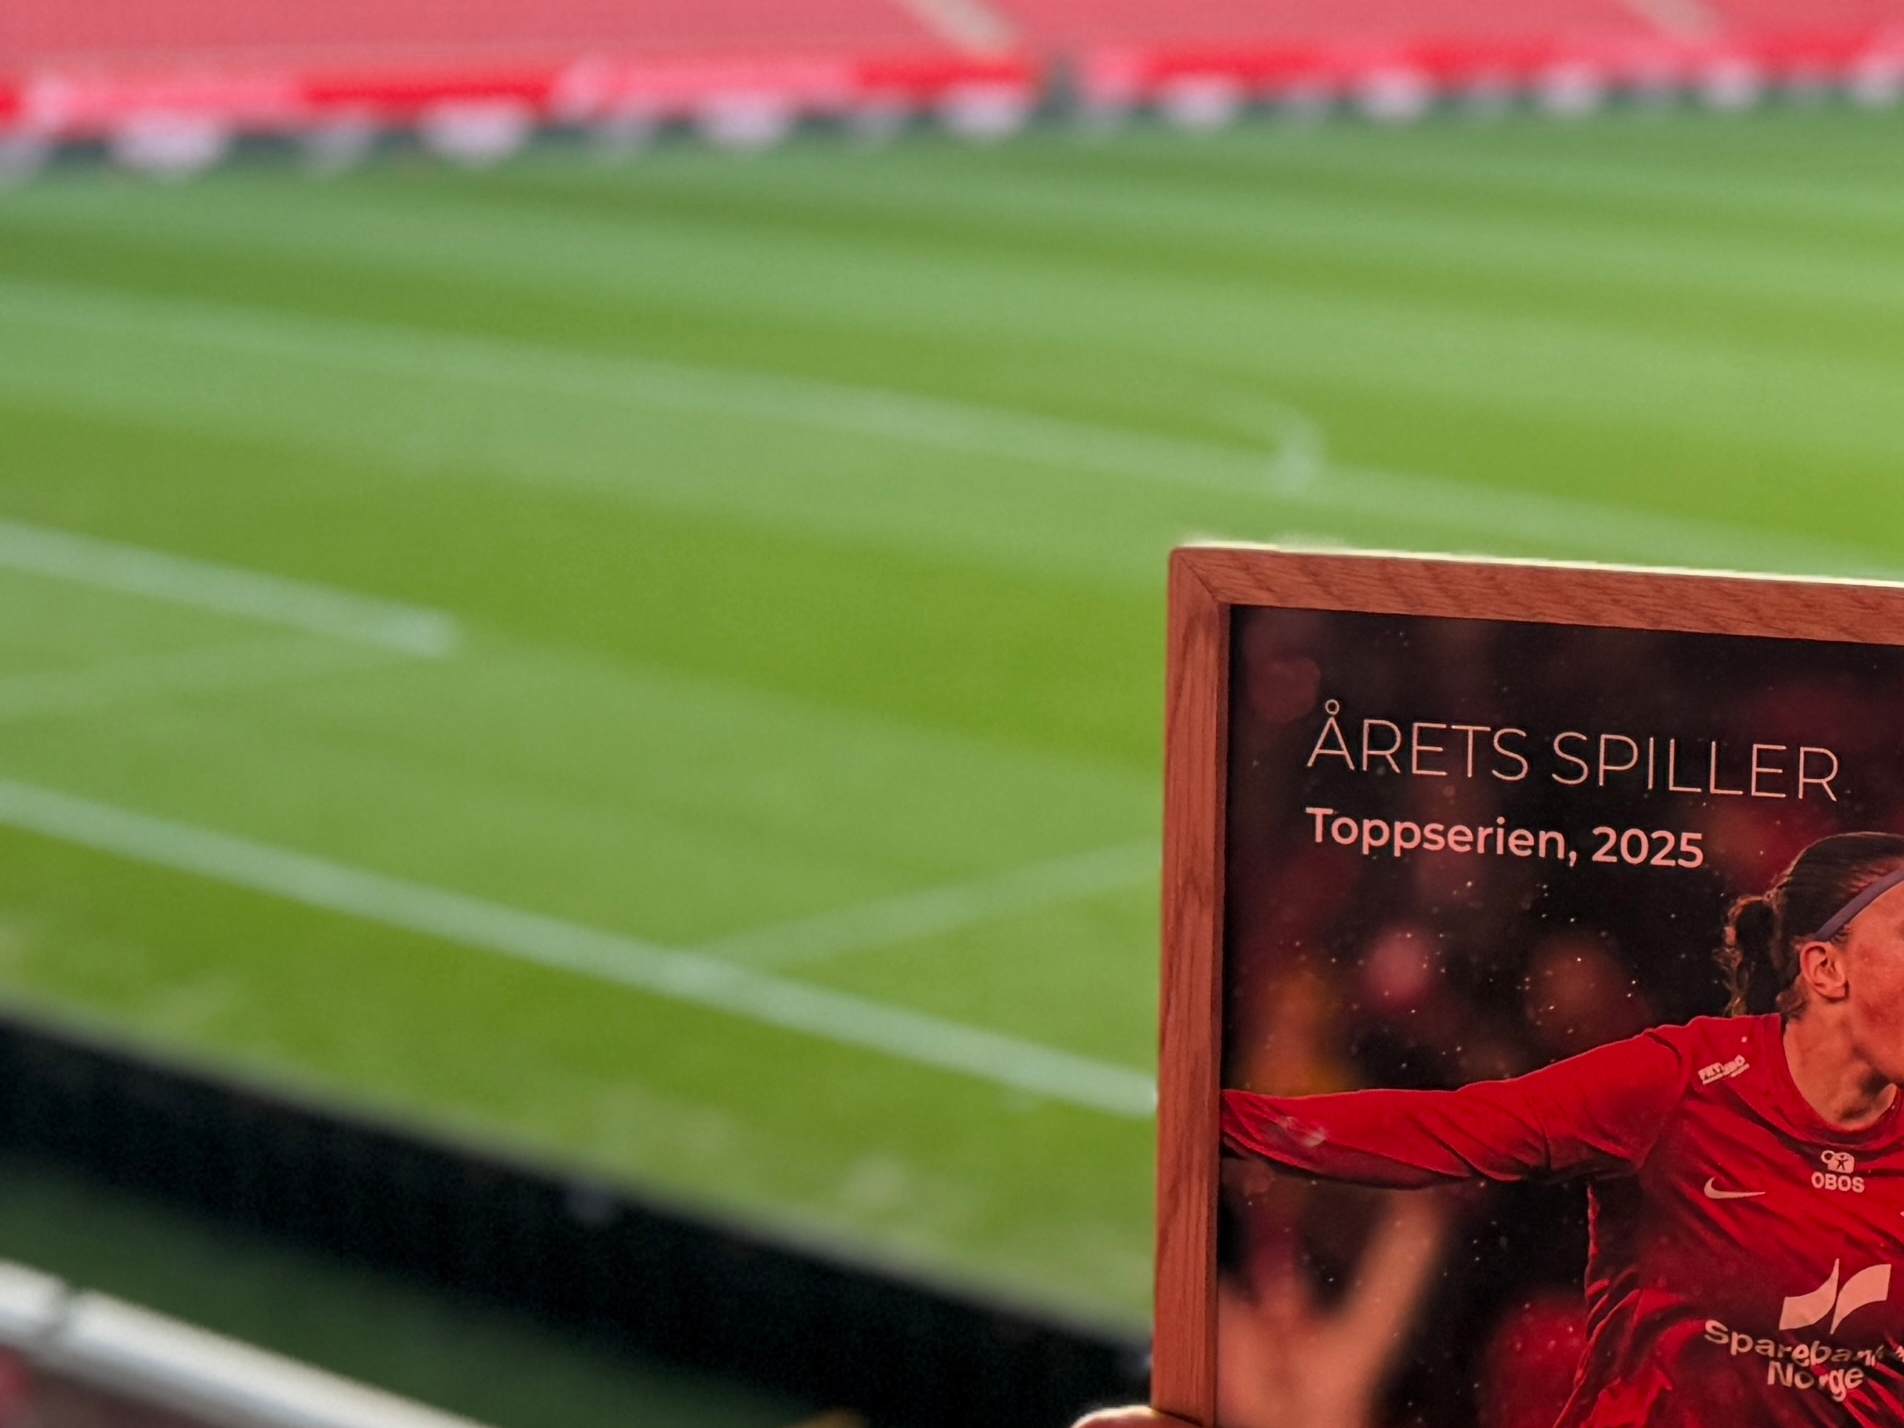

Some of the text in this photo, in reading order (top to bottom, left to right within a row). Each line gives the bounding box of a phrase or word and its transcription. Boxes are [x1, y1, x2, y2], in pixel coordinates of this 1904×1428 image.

[1306, 698, 1840, 802] ÅRETS SPILLER
[1305, 806, 1704, 869] Toppserien, 2025
[1811, 1173, 1866, 1194] OBOS
[1767, 1360, 1865, 1403] Norge
